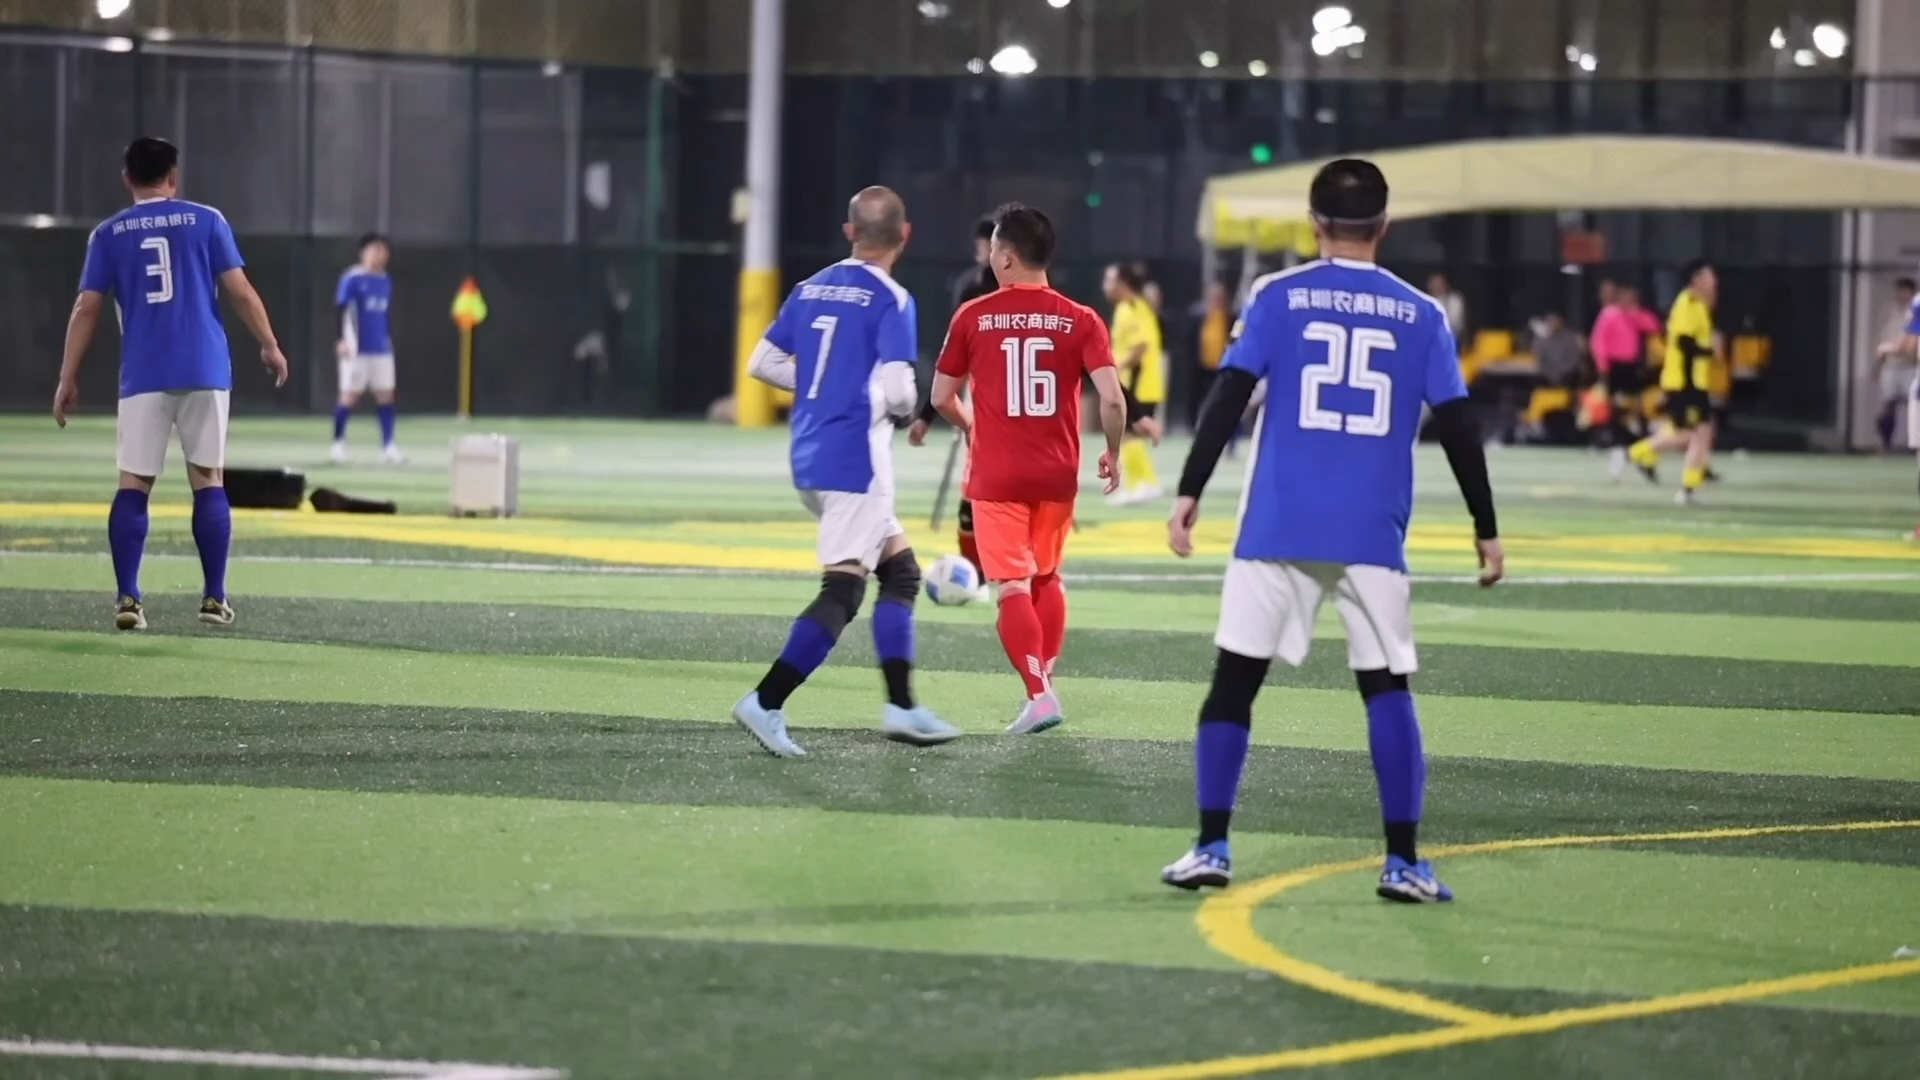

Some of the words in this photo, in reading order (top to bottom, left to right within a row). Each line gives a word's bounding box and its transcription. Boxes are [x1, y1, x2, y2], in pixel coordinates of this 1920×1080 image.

[112, 213, 196, 236] 深圳农商银行
[140, 237, 173, 304] 3
[978, 313, 1074, 334] 深圳农商银行
[1287, 287, 1416, 324] 深圳农商银行
[806, 315, 839, 399] 7
[1000, 337, 1056, 417] 16
[1299, 321, 1397, 437] 25
